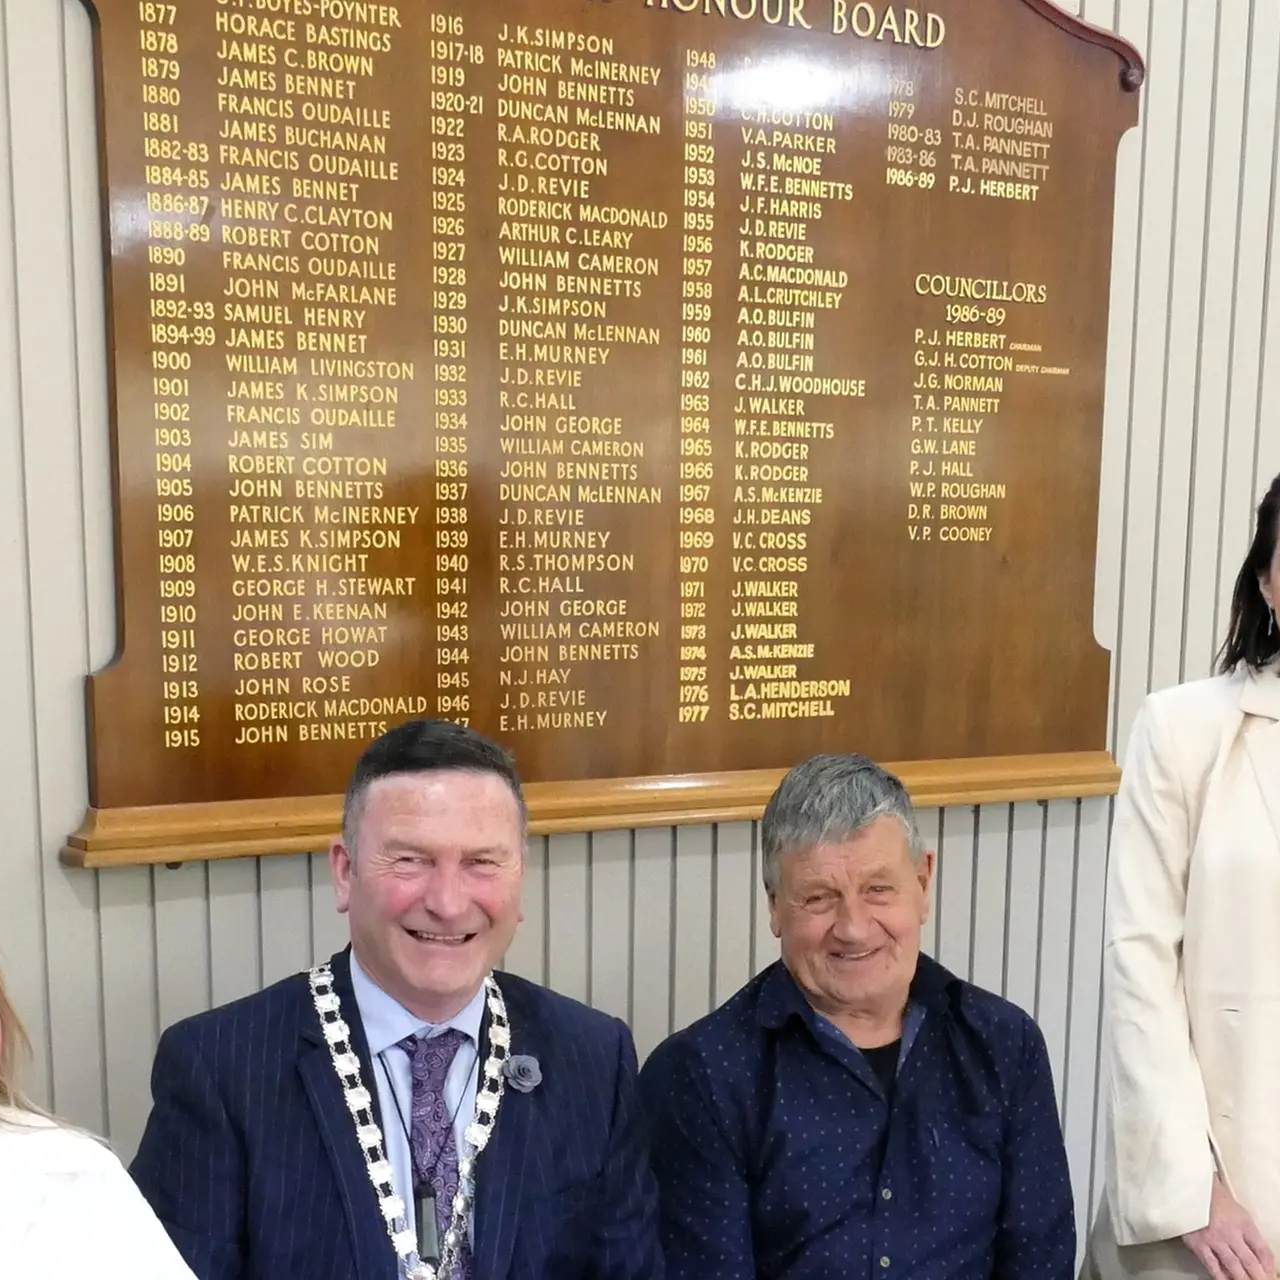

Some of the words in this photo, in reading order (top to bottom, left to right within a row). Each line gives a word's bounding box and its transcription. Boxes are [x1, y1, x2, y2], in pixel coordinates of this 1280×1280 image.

[139, 1, 177, 25] 1877
[216, 11, 296, 41] HORACE
[306, 23, 391, 52] BASTINGS
[832, 0, 946, 48] BOARD
[431, 39, 484, 64] 1917-18
[497, 48, 562, 74] PATRICK
[571, 57, 661, 86] McINERNEY
[142, 56, 180, 80] 1879
[217, 66, 276, 91] JAMES
[285, 73, 356, 100] BENNET
[431, 65, 465, 87] 1919
[497, 73, 547, 97] JOHN
[558, 80, 634, 107] BENNETTS
[431, 91, 483, 115] 1920-21
[498, 98, 568, 124] DUNCAN
[576, 107, 660, 135] McLENNAN
[144, 112, 178, 133] 1881
[219, 119, 276, 143] JAMES
[285, 126, 385, 154] BUCHANAN
[888, 123, 941, 146] 1980-83
[983, 135, 1050, 159] PANNETT
[144, 137, 209, 163] 1882-83
[219, 144, 299, 170] FRANCIS
[309, 153, 398, 180] OUDAILLE
[684, 142, 715, 164] 1952
[886, 167, 935, 189] 1986-89
[980, 179, 1040, 201] HERBERT
[433, 191, 466, 212] 1925
[498, 196, 572, 221] RODERICK
[579, 204, 668, 229] MACDONALD
[684, 212, 714, 231] 1955
[149, 222, 210, 242] 1888-89
[222, 225, 292, 248] ROBERT
[301, 231, 379, 255] COTTON
[433, 241, 466, 261] 1927
[499, 246, 569, 269] WILLIAM
[578, 253, 658, 276] CAMERON
[683, 257, 712, 277] 1957
[150, 272, 185, 293] 1891
[223, 277, 279, 298] JOHN
[292, 282, 396, 306] McFARLANE
[915, 273, 1047, 303] COUNCILLORS
[150, 298, 215, 320] 1892-93
[224, 303, 293, 324] SAMUEL
[304, 307, 366, 328] HENRY
[946, 304, 1006, 326] 1986-89
[946, 330, 1006, 349] HERBERT
[152, 351, 191, 370] 1900
[225, 354, 297, 375] WILLIAM
[311, 358, 413, 380] LIVINGSTON
[959, 353, 1013, 371] COTTON
[944, 374, 1003, 392] NORMAN
[681, 394, 709, 412] 1963
[749, 397, 805, 416] WALKER
[436, 412, 468, 429] 1934
[500, 414, 546, 432] JOHN
[555, 416, 622, 435] GEORGE
[155, 428, 191, 446] 1903
[228, 430, 288, 448] JAMES
[301, 432, 332, 449] SIM
[943, 440, 976, 456] LANE
[157, 478, 193, 496] 1905
[229, 479, 282, 497] JOHN
[296, 480, 383, 499] BENNETTS
[158, 504, 194, 522] 1906
[230, 505, 304, 523] PATRICK
[314, 505, 419, 524] McINERNEY
[680, 507, 715, 524] 1968
[436, 530, 468, 548] 1939
[681, 581, 704, 598] 1971
[162, 629, 195, 649] 1911
[233, 628, 310, 647] GEORGE
[322, 626, 387, 644] HOWAT
[437, 624, 468, 642] 1943
[500, 622, 571, 640] WILLIAM
[579, 621, 659, 638] CAMERON
[164, 680, 198, 699] 1913
[235, 677, 290, 696] JOHN
[302, 675, 350, 694] ROSE
[164, 705, 200, 724] 1914
[235, 700, 318, 721] RODERICK
[324, 696, 427, 717] MACDONALD
